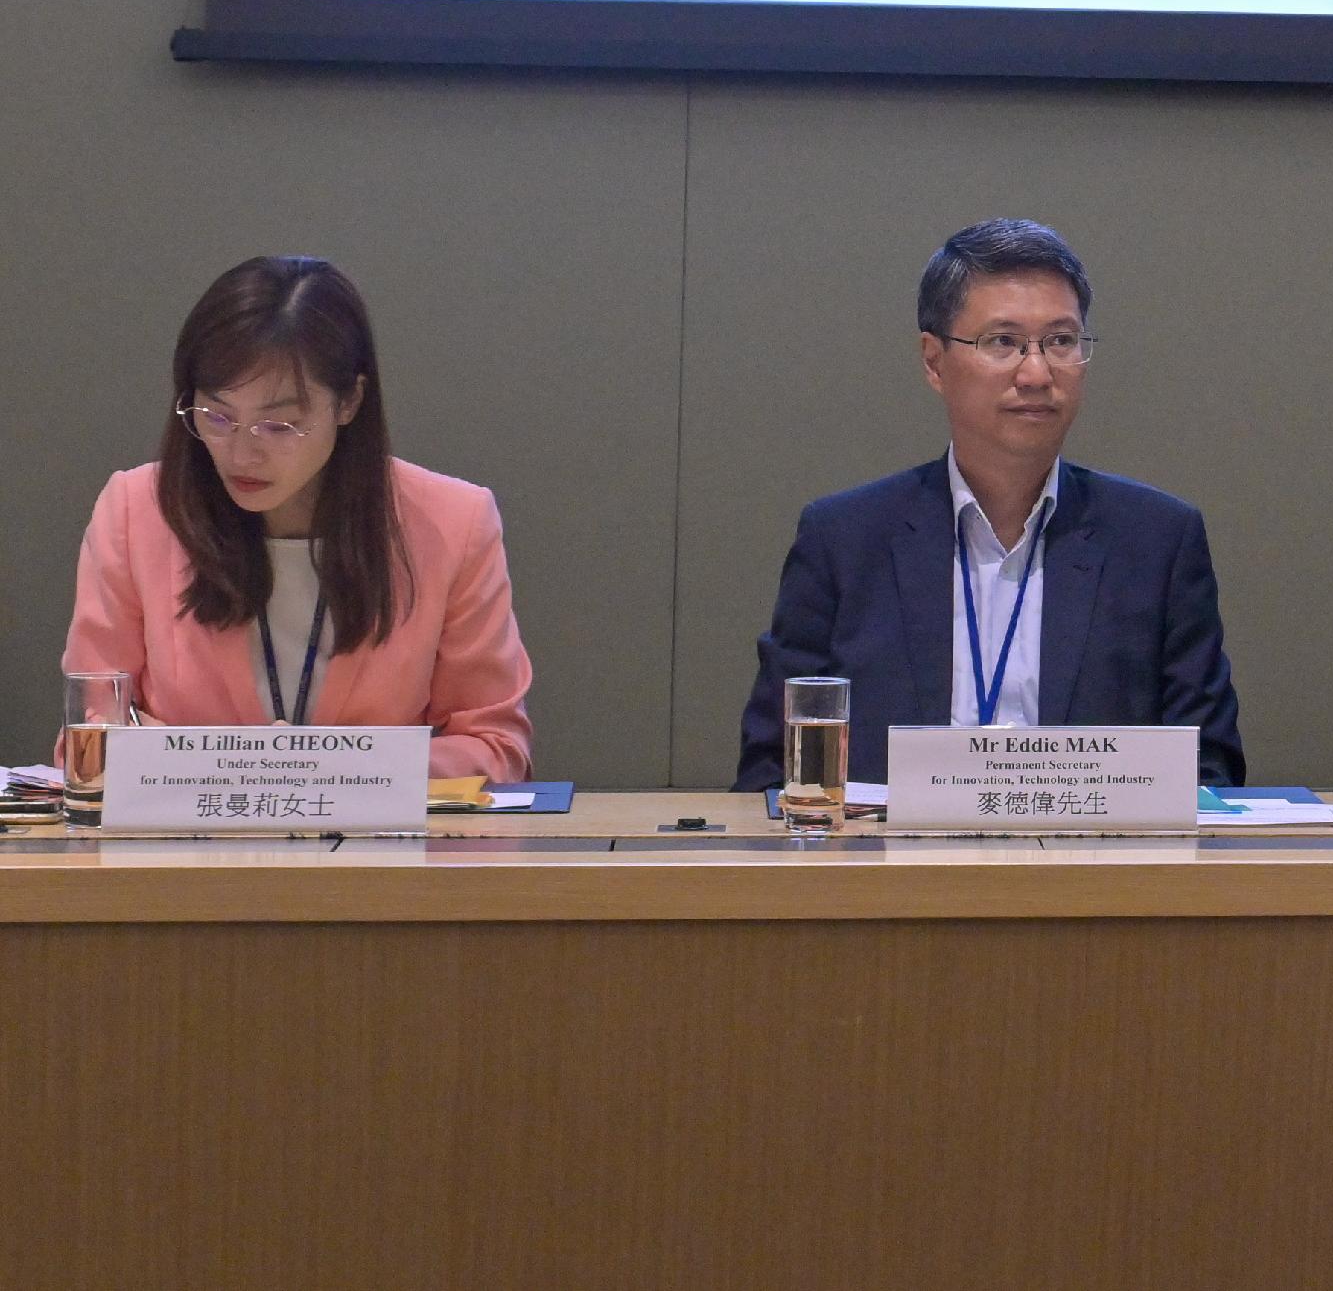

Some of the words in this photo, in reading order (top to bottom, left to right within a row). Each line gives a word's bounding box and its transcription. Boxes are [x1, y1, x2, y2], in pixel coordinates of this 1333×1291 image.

[164, 735, 195, 751] Ms
[202, 735, 265, 751] Lillian
[272, 734, 373, 751] CHEONG
[969, 737, 1000, 753] Mr
[1005, 737, 1059, 753] Eddie
[1065, 737, 1119, 753] MAK
[217, 758, 257, 769] Under
[260, 758, 320, 772] Secretary
[985, 760, 1046, 770] Permanent
[1048, 760, 1101, 772] Secretary
[140, 775, 158, 785] for
[162, 775, 234, 786] Innovation,
[240, 775, 307, 788] Technology
[312, 775, 335, 785] and
[339, 775, 392, 788] Industry
[931, 775, 947, 785] for
[952, 775, 1015, 785] Innovation,
[1019, 774, 1079, 787] Technology
[1083, 774, 1103, 784] and
[1107, 774, 1153, 786] Industry
[196, 792, 335, 818] 張曼莉女士
[977, 791, 1108, 816] 麥德偉先生
